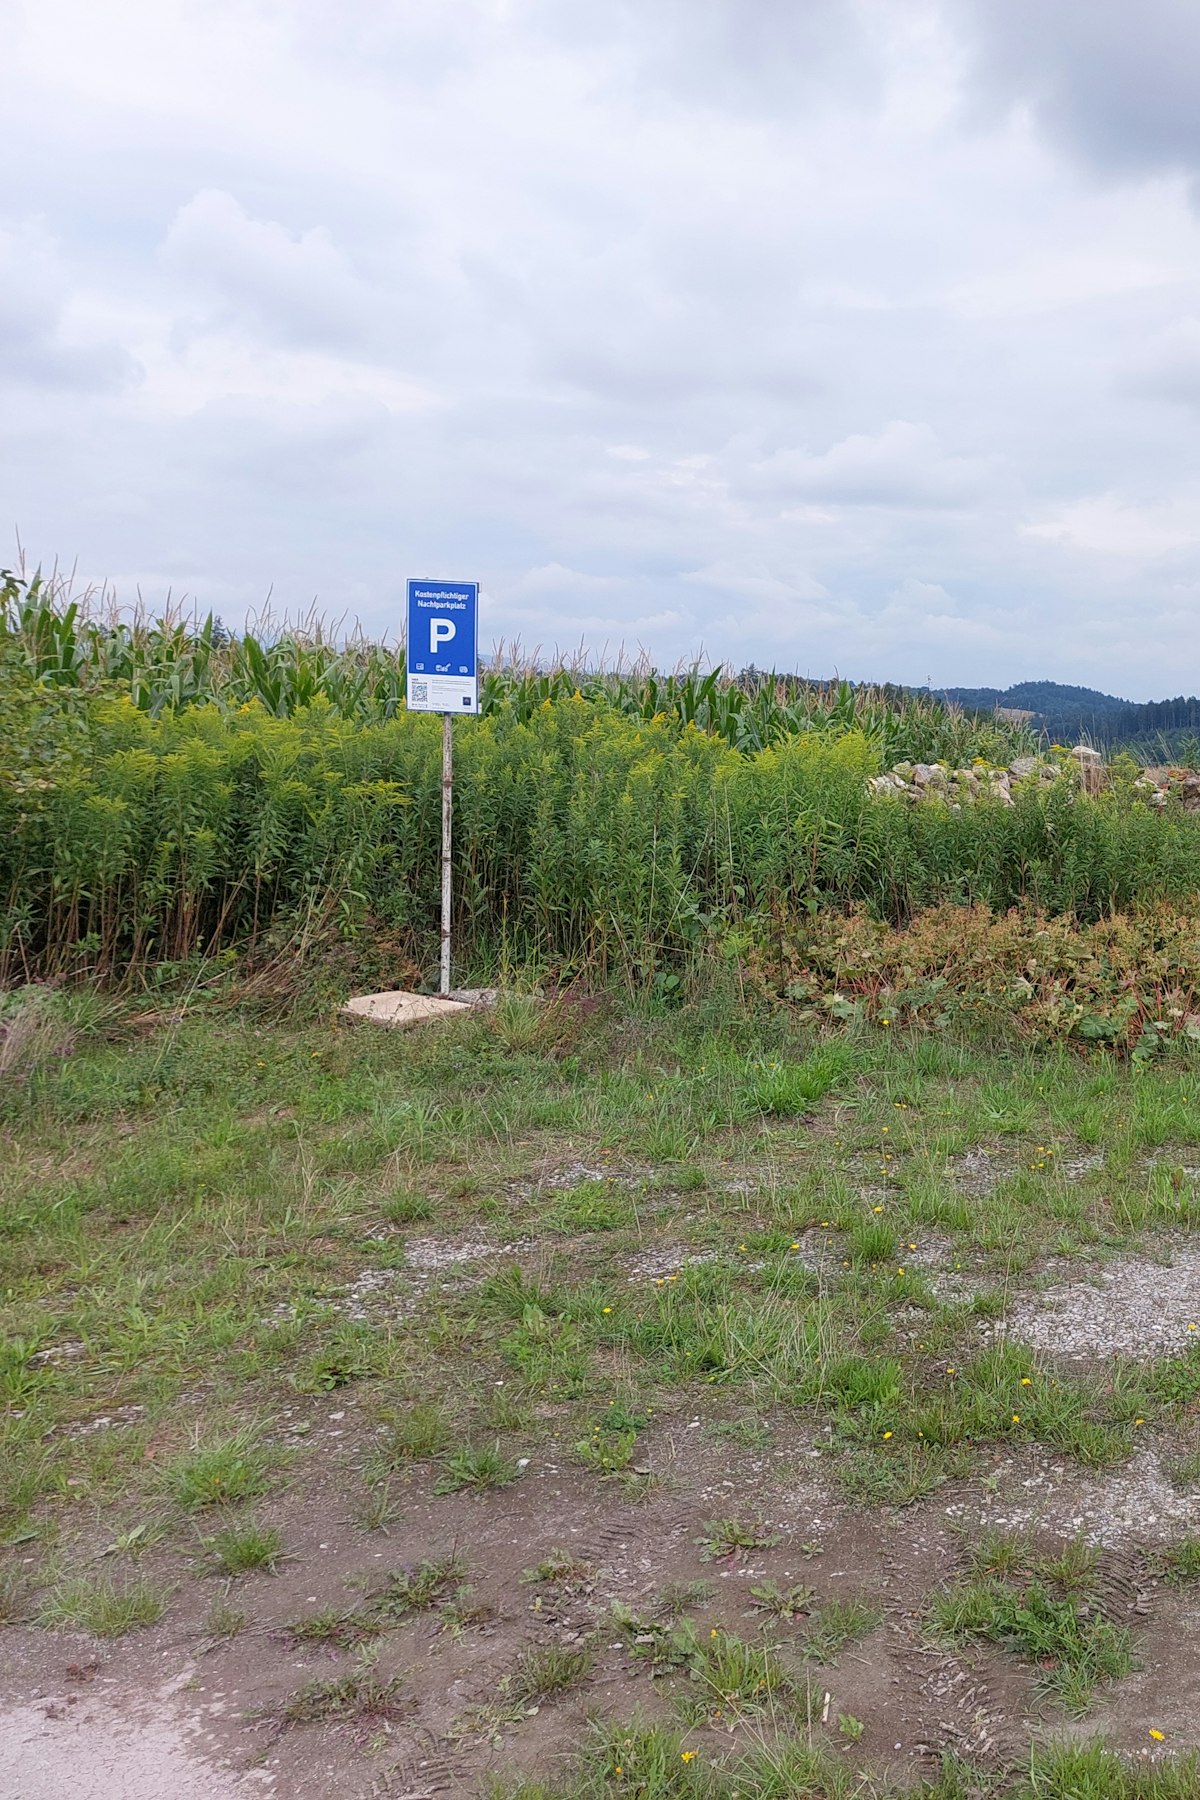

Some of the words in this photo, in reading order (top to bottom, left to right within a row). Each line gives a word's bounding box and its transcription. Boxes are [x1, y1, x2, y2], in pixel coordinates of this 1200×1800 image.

[414, 590, 469, 601] Kostenpflichtiger
[417, 600, 466, 610] Nachtparkplatz
[430, 618, 456, 653] P
